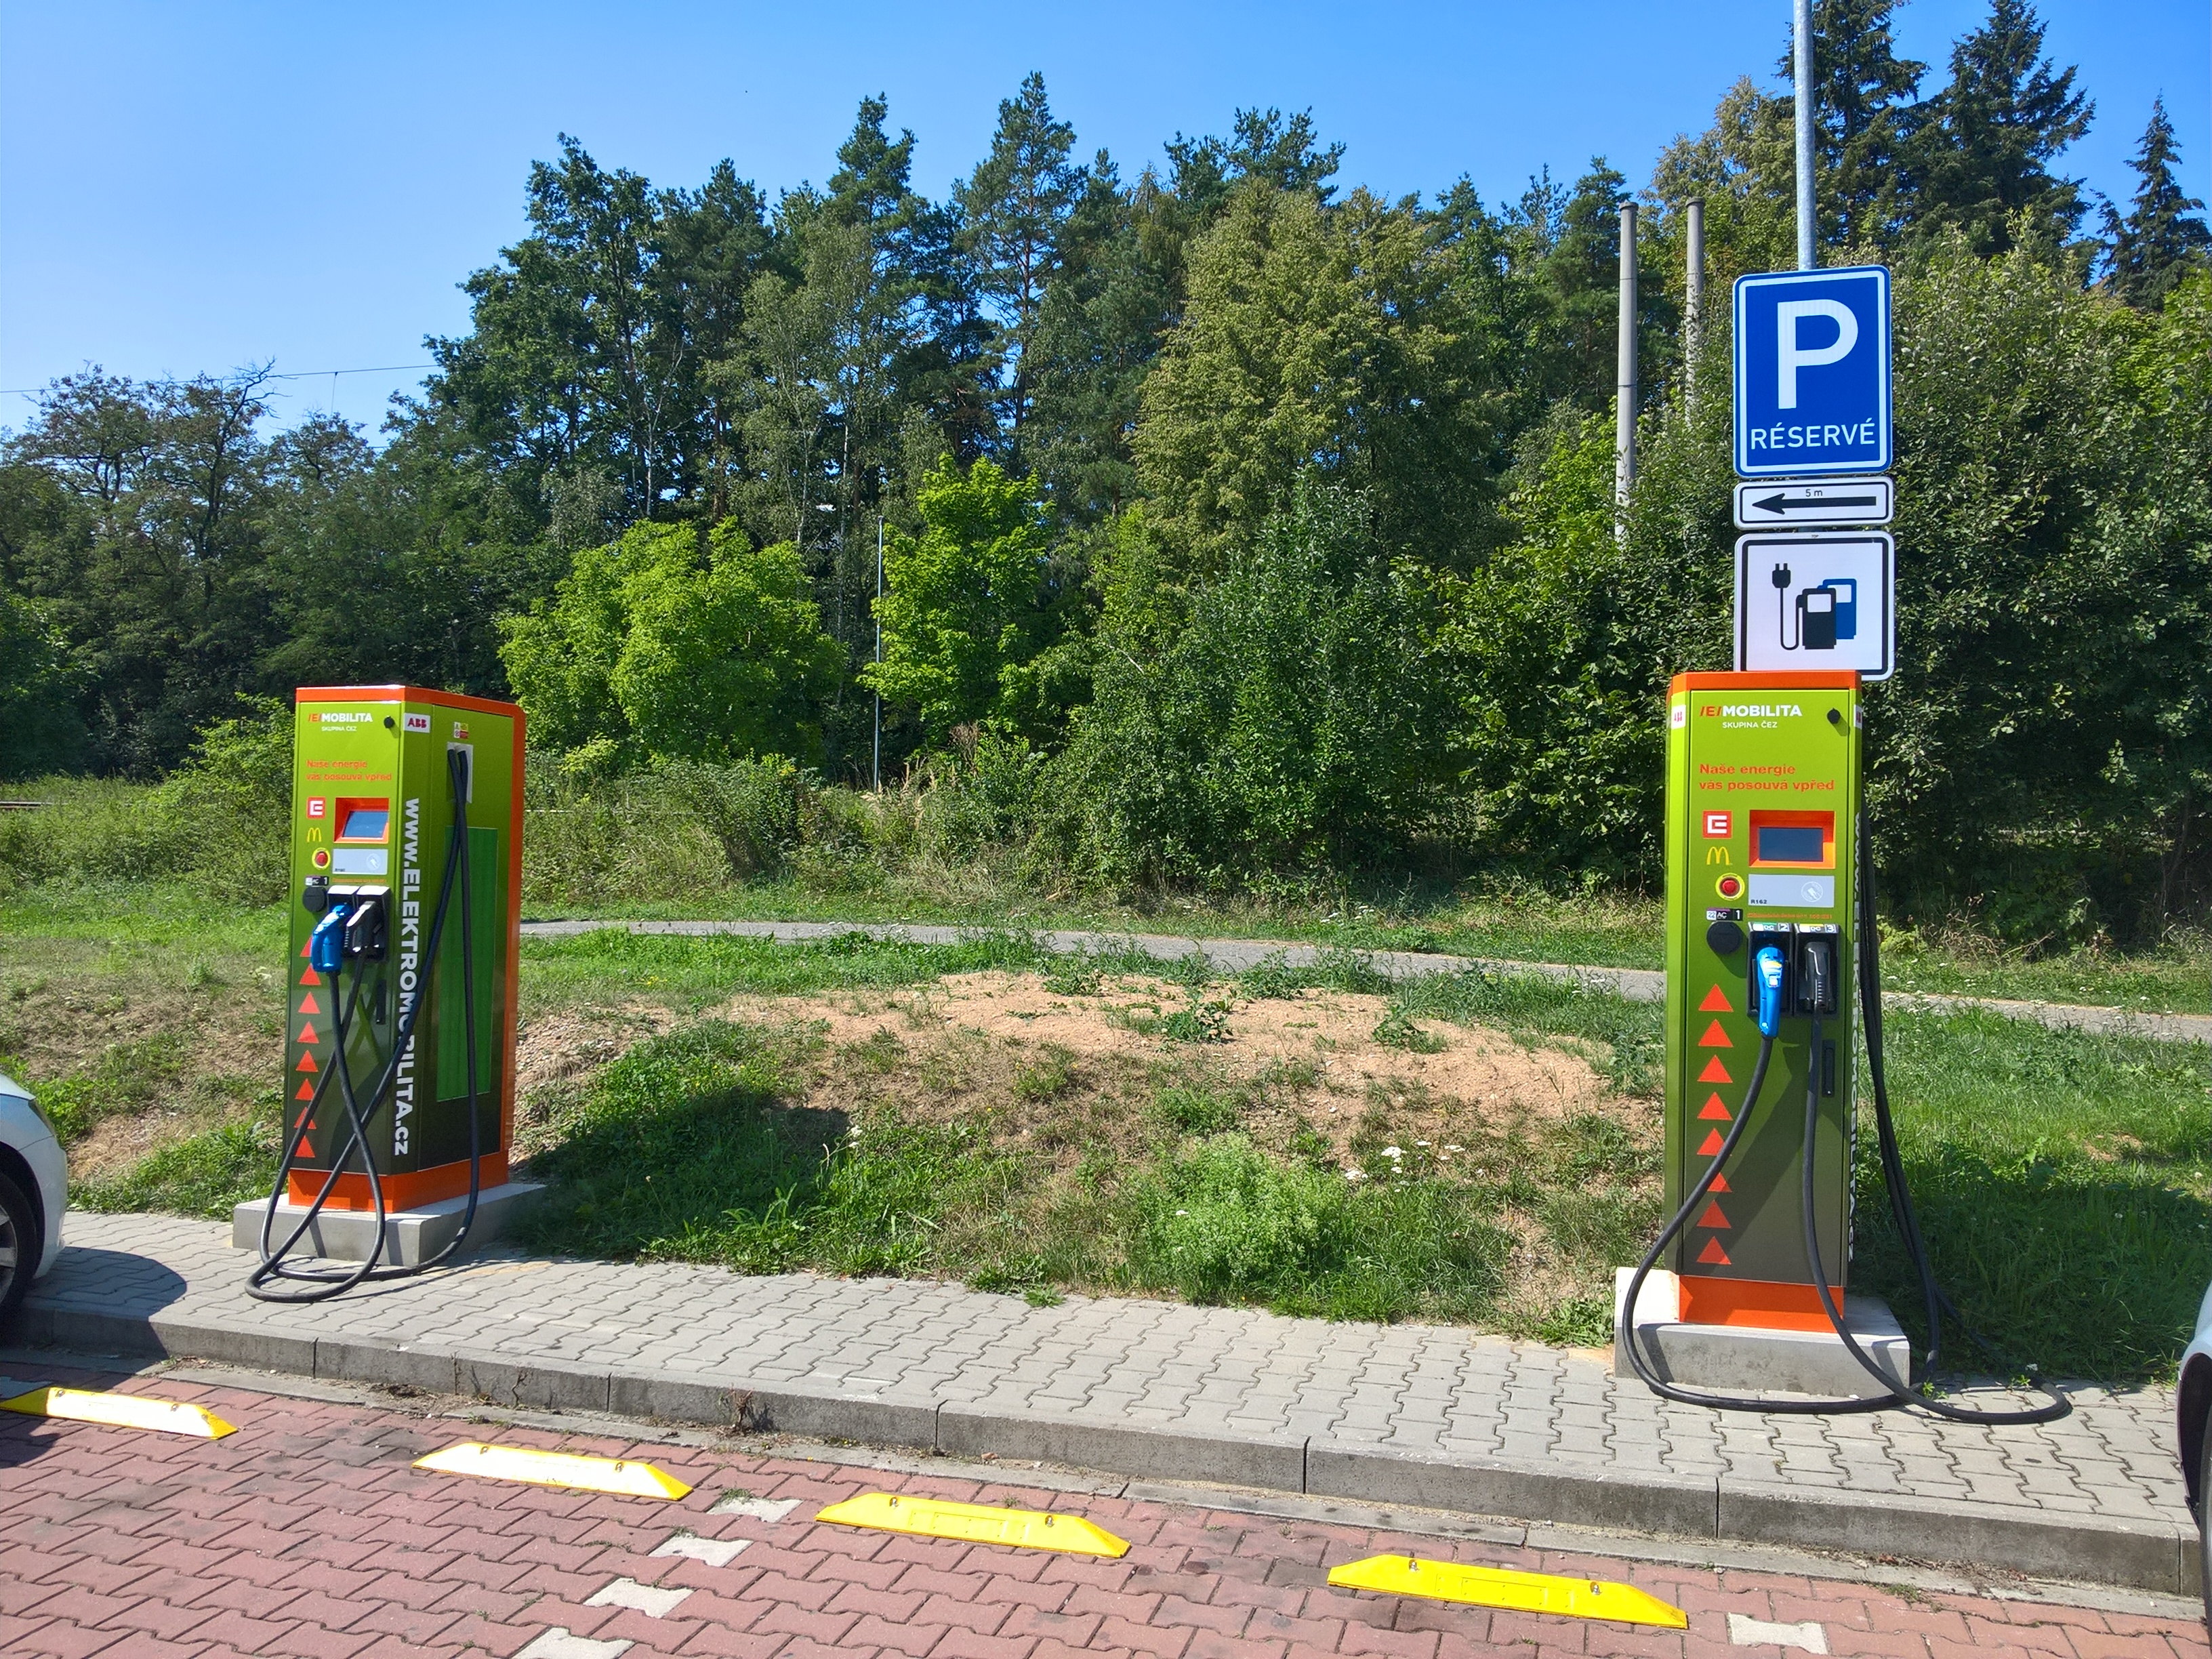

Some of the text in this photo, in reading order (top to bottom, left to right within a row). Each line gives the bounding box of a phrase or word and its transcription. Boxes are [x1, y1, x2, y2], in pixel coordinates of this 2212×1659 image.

[1778, 299, 1858, 409] P
[1751, 417, 1875, 450] RÉSERVÉ
[1805, 489, 1811, 497] 5
[407, 718, 427, 729] ABB
[1761, 720, 1778, 729] ČEZ
[1700, 763, 1795, 776] Naše energie
[1700, 780, 1835, 793] vás posouvá vpřed
[1736, 910, 1740, 920] 1
[1826, 924, 1835, 933] 3
